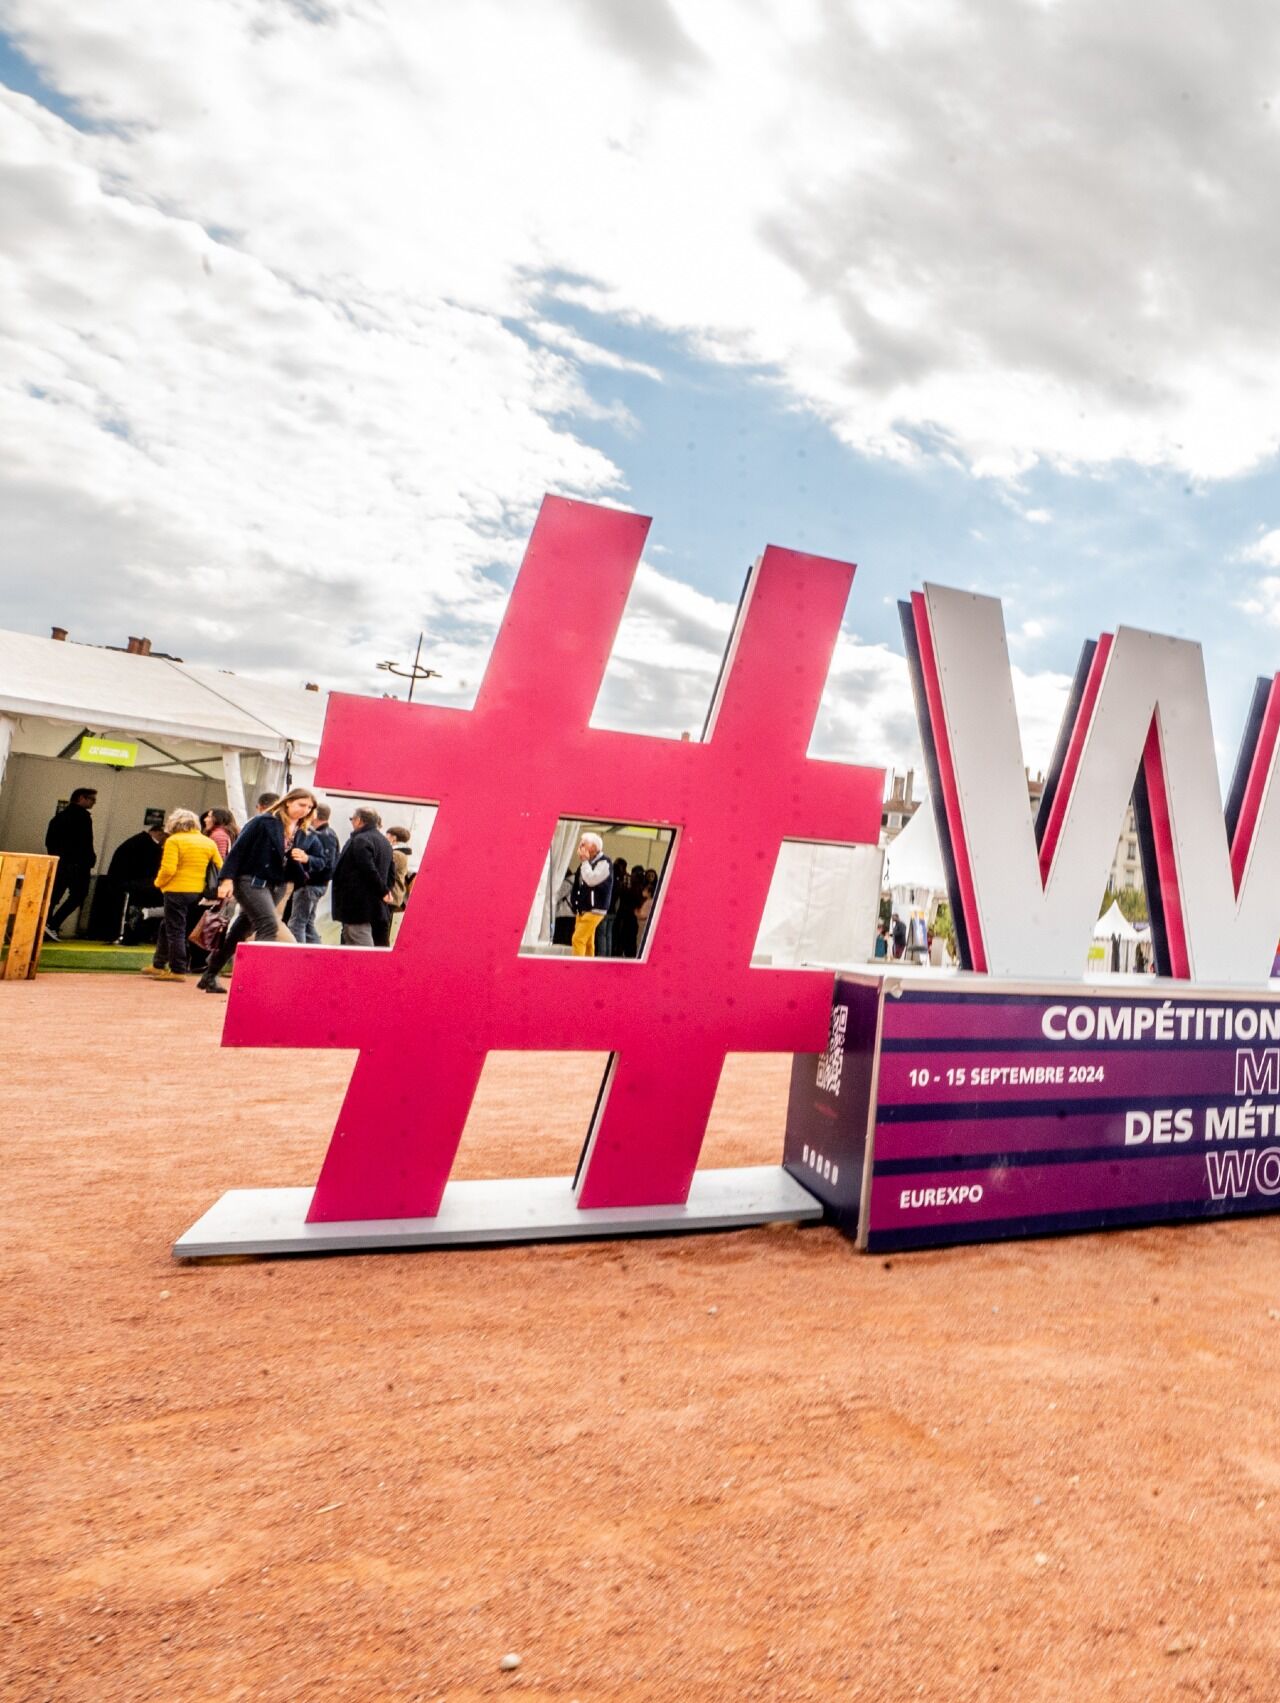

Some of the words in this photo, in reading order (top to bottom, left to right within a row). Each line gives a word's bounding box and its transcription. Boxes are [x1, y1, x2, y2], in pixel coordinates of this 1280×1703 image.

[909, 1068, 930, 1087] 10
[946, 1068, 966, 1086] 15
[970, 1066, 1064, 1085] SEPTEMBRE
[1068, 1065, 1105, 1083] 2024
[1125, 1109, 1194, 1145] DES
[900, 1184, 983, 1210] EUREXPO
